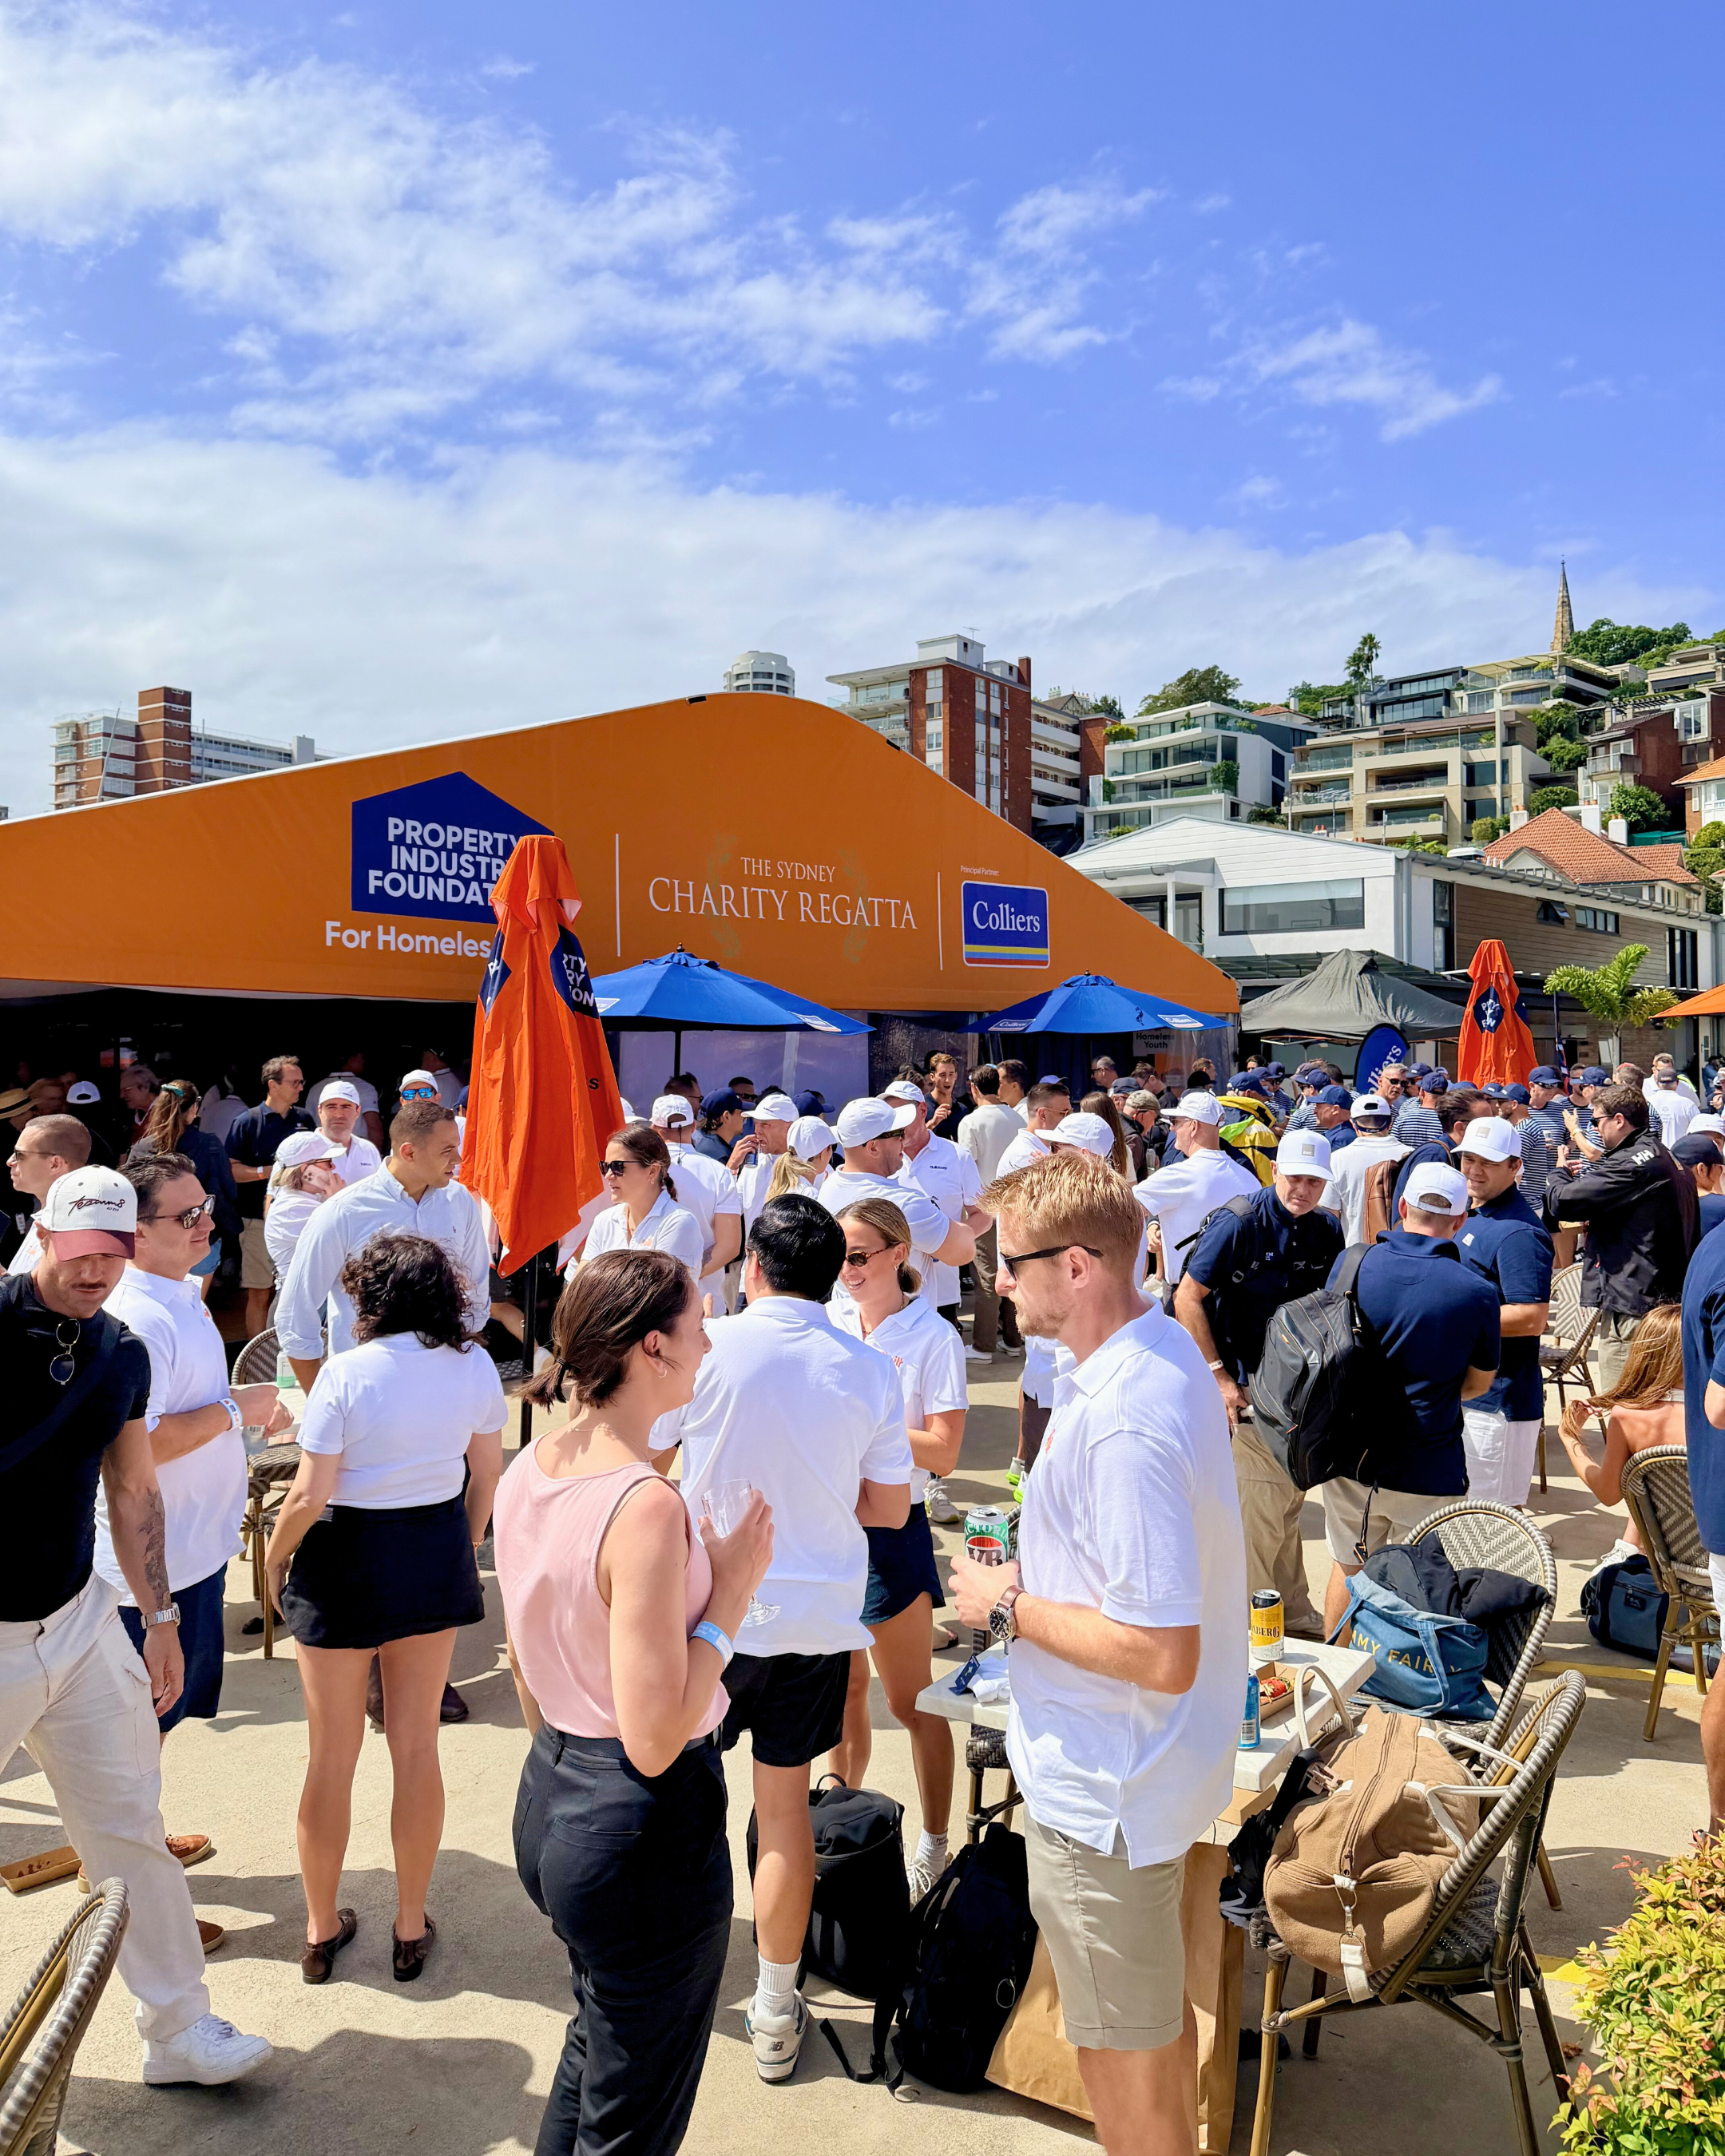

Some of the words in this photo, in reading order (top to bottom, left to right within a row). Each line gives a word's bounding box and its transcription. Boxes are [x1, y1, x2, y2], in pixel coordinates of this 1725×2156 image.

[391, 845, 508, 881] INDUSTR
[740, 857, 771, 877] THE
[777, 861, 835, 882] SYDNEY
[961, 865, 981, 875] Principal
[648, 877, 789, 921] CHARITY
[798, 891, 918, 929] REGATTA
[972, 900, 1041, 933] Colliers
[325, 921, 371, 949] For
